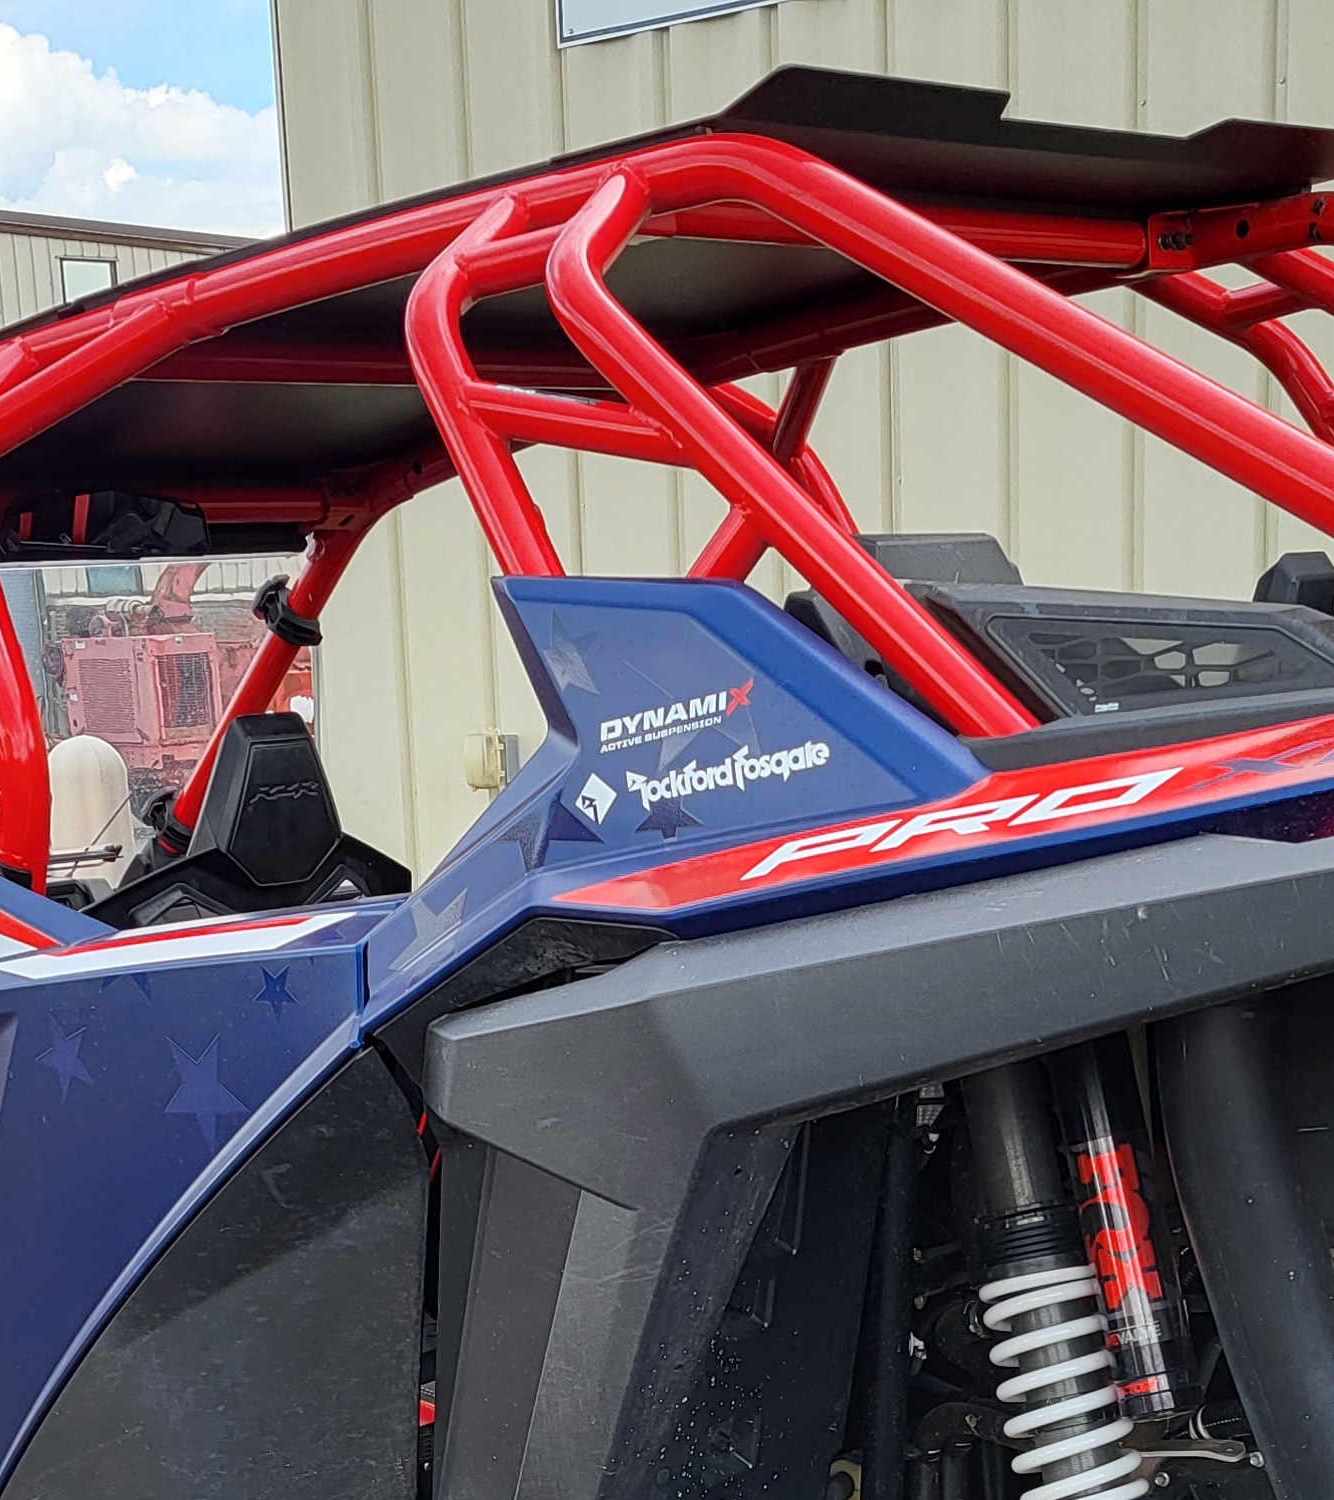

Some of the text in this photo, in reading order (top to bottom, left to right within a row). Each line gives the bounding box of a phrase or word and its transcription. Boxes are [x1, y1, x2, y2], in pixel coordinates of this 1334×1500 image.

[600, 678, 754, 742] DYNAMIX
[600, 715, 723, 754] ACTIVE SUSPENSION
[740, 767, 1183, 881] PRO
[1077, 1142, 1164, 1311] FOX
